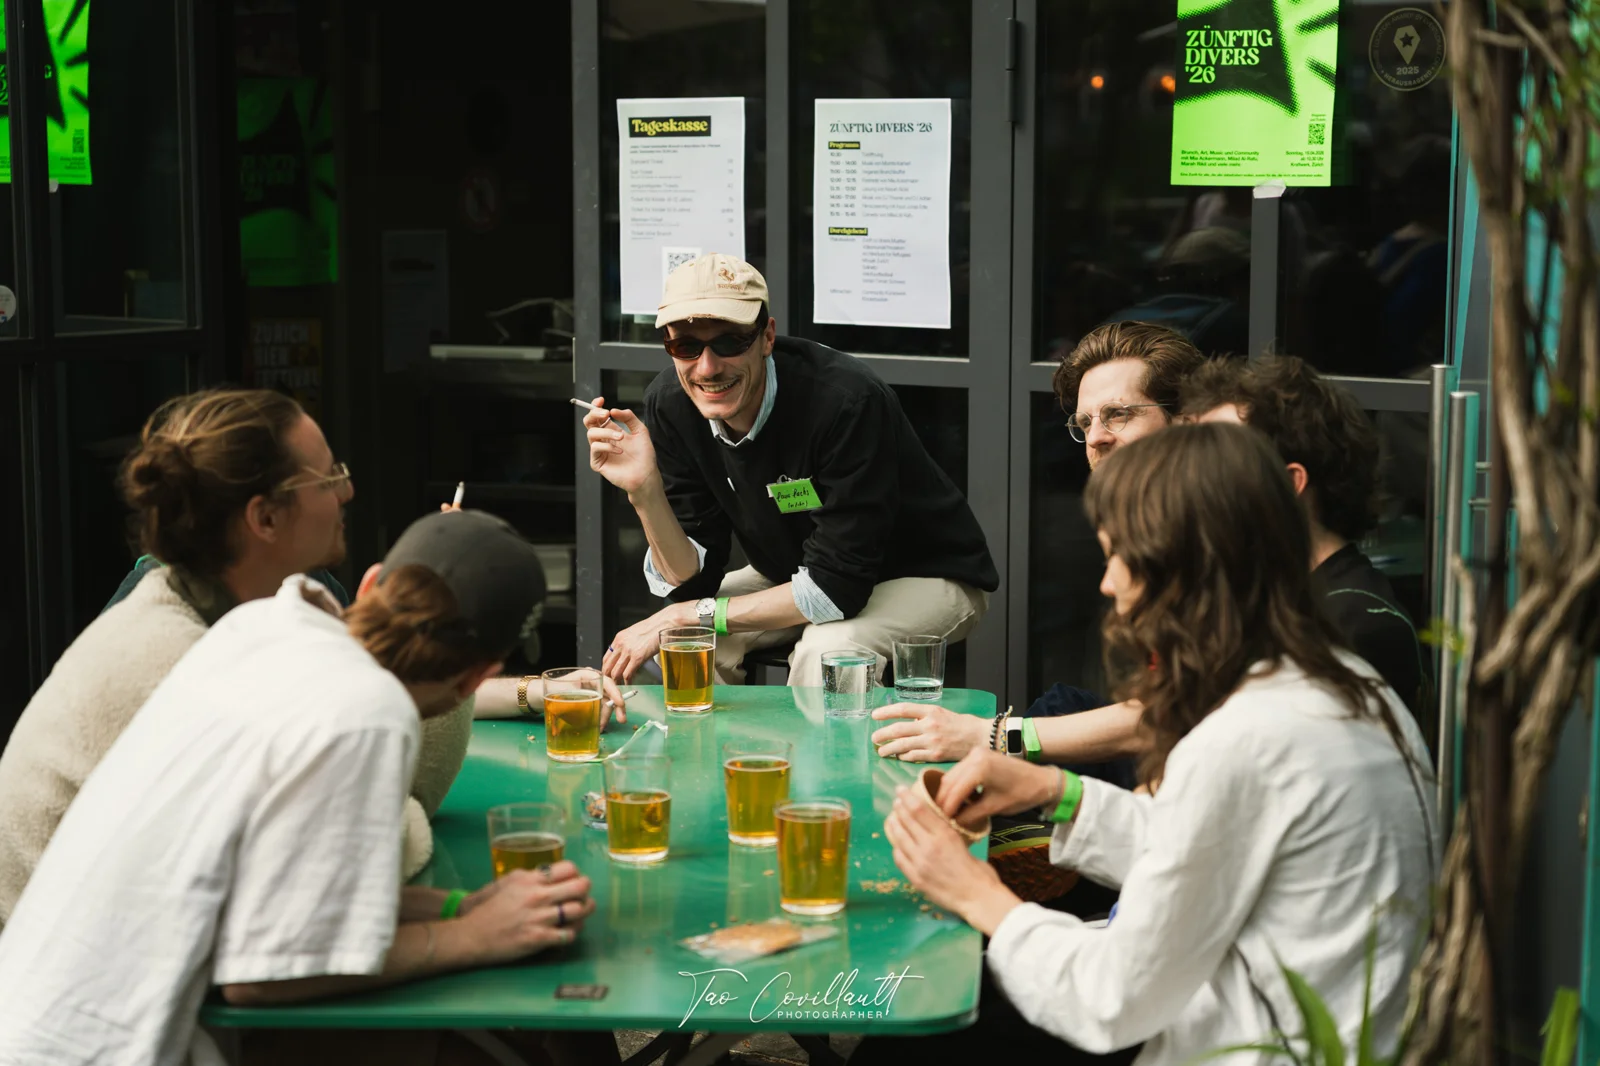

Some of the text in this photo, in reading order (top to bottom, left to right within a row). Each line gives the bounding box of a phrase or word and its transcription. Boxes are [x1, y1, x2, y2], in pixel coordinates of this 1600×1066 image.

[1186, 25, 1272, 47] ZÜNFTIG
[1185, 48, 1260, 66] DIVERS
[1185, 66, 1216, 84] '26
[1384, 69, 1432, 86] HERAUSRAGEND
[1396, 66, 1420, 75] 2025
[632, 118, 708, 136] Tageskasse
[830, 120, 873, 133] ZÜNFTIG
[876, 122, 914, 133] DIVERS
